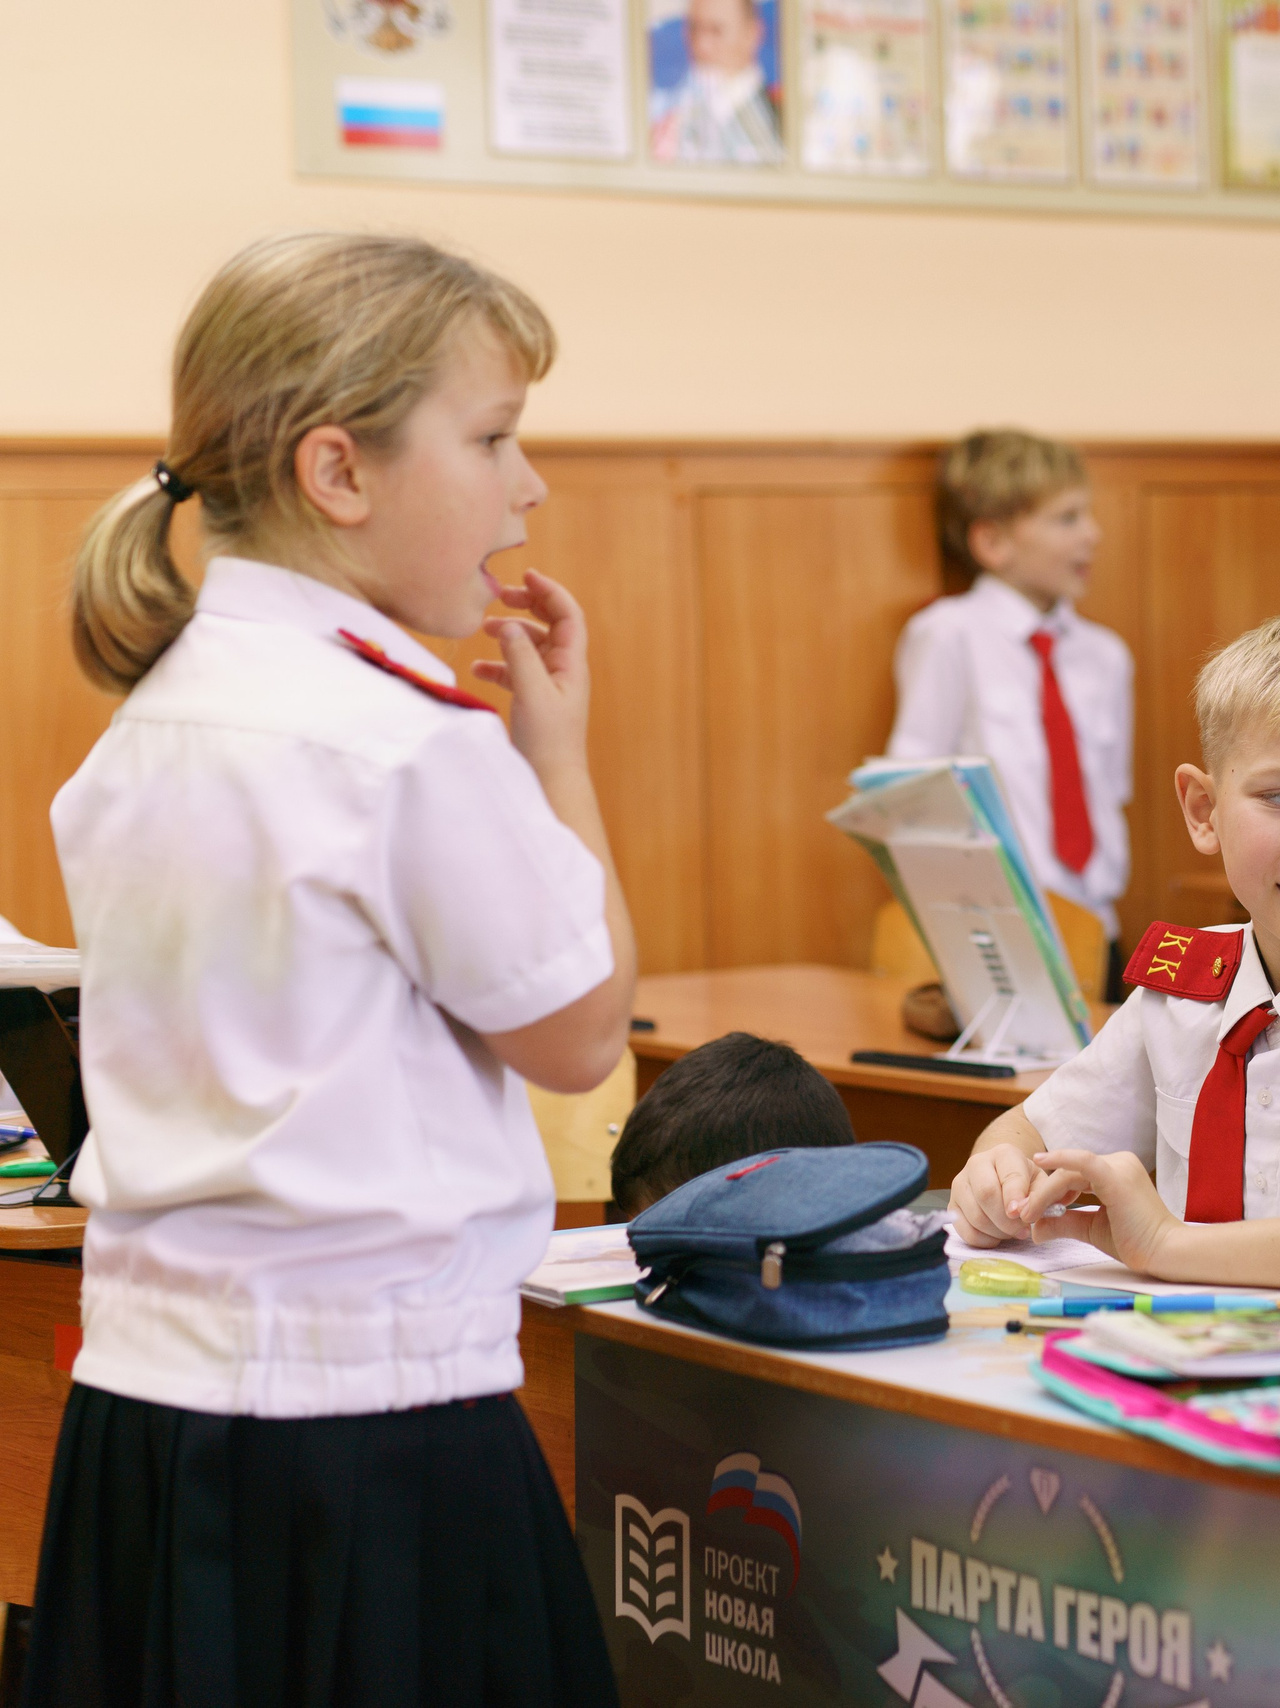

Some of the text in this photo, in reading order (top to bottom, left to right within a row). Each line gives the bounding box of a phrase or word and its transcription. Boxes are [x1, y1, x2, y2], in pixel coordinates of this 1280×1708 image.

[704, 1546, 780, 1597] ПРОЕКТ
[705, 1589, 774, 1639] НОВАЯ
[910, 1537, 1192, 1691] ПАРТА ГЕРОЯ
[705, 1632, 781, 1686] ШКОЛА
